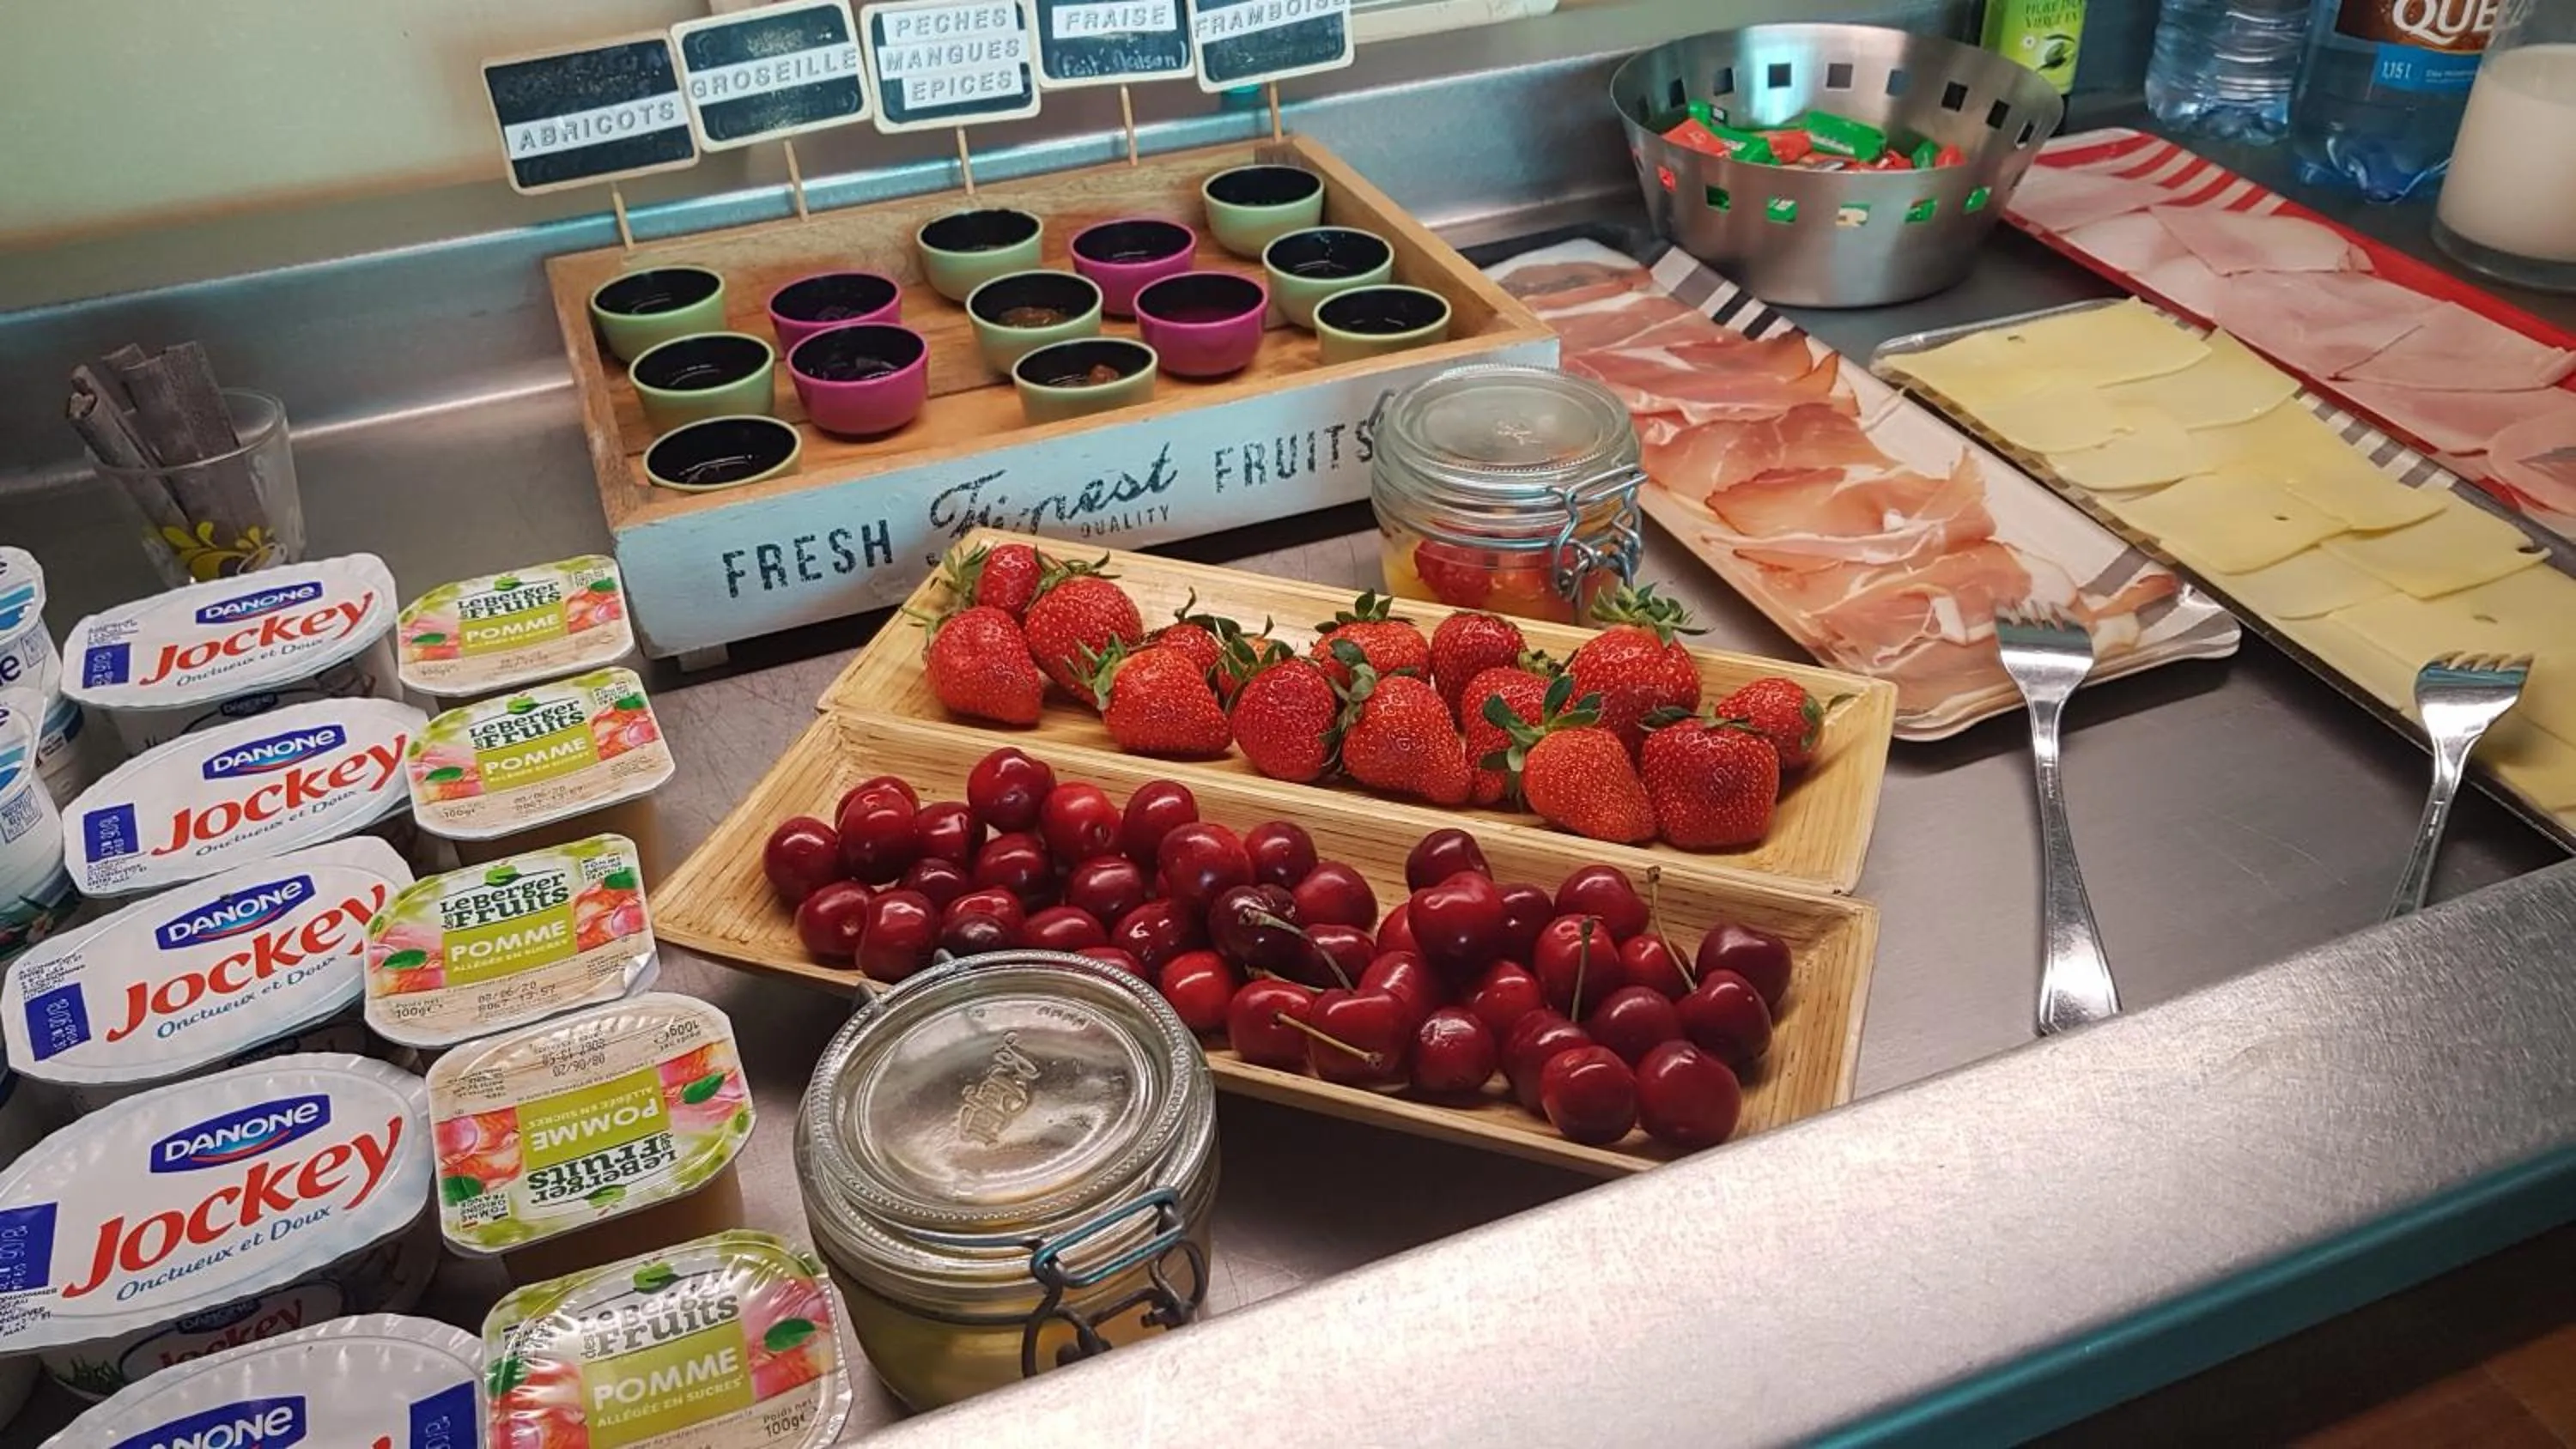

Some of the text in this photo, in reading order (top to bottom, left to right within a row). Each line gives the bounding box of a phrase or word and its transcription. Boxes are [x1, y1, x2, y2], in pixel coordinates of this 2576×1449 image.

[895, 8, 1008, 38] PECHES
[1066, 5, 1166, 31] FRAISE
[1195, 0, 1346, 38] FRAMBOI
[690, 49, 857, 97] GROSEILLE
[885, 39, 1021, 71] MANGUES
[910, 70, 1013, 101] EPICES
[519, 102, 675, 151] ABRICOTS
[1213, 416, 1375, 494] FRUITS
[929, 443, 1178, 537] Finest
[1078, 503, 1172, 539] QUALITY
[722, 520, 895, 598] FRESH
[204, 587, 316, 619] DANONE
[472, 591, 562, 619] Fruits
[139, 592, 374, 686] Jockey
[465, 613, 560, 643] POMME
[176, 639, 325, 687] Onctueux et Doux
[213, 730, 337, 773] DANONE
[486, 712, 585, 749] Fruits
[484, 737, 587, 774] POMME
[151, 733, 408, 856] Jockey
[196, 791, 357, 856] Onctueux et Doux
[167, 881, 303, 940] DANONE
[454, 884, 569, 929] Fruits
[106, 883, 386, 1043] Jockey
[451, 920, 567, 961] POMME
[157, 955, 337, 1039] Onctueux et Doux
[165, 1102, 319, 1162] DANONE
[532, 1097, 659, 1150] POMME
[527, 1139, 658, 1191] Fruits
[62, 1116, 403, 1298] Jockey
[116, 1204, 332, 1301] Onctueux et Doux
[598, 1296, 739, 1355] Fruits
[592, 1348, 739, 1410] POMME
[663, 1393, 683, 1409] EN
[149, 1405, 294, 1449] NONE
